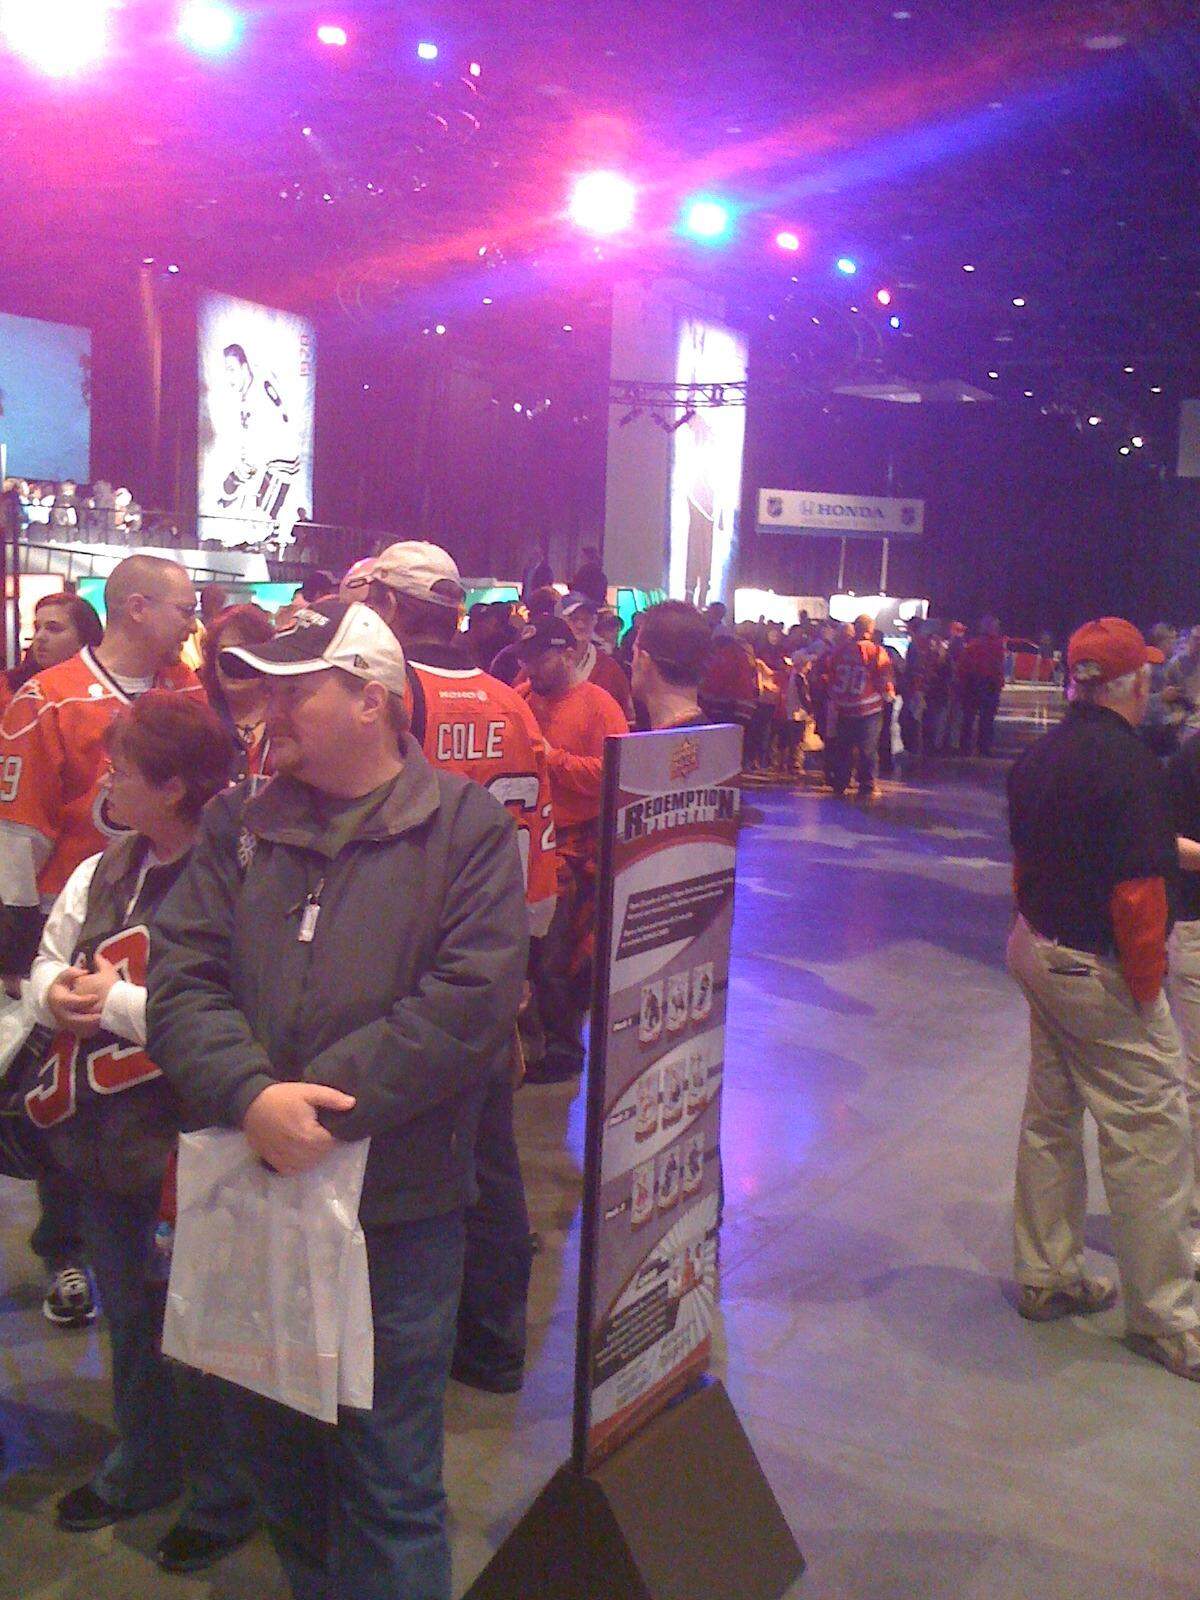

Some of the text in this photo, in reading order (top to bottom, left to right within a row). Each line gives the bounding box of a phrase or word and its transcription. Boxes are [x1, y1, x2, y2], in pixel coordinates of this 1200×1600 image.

[817, 503, 884, 519] HONDA
[437, 720, 506, 761] COLE
[0, 755, 22, 802] 9
[623, 787, 735, 841] REDEMPTION
